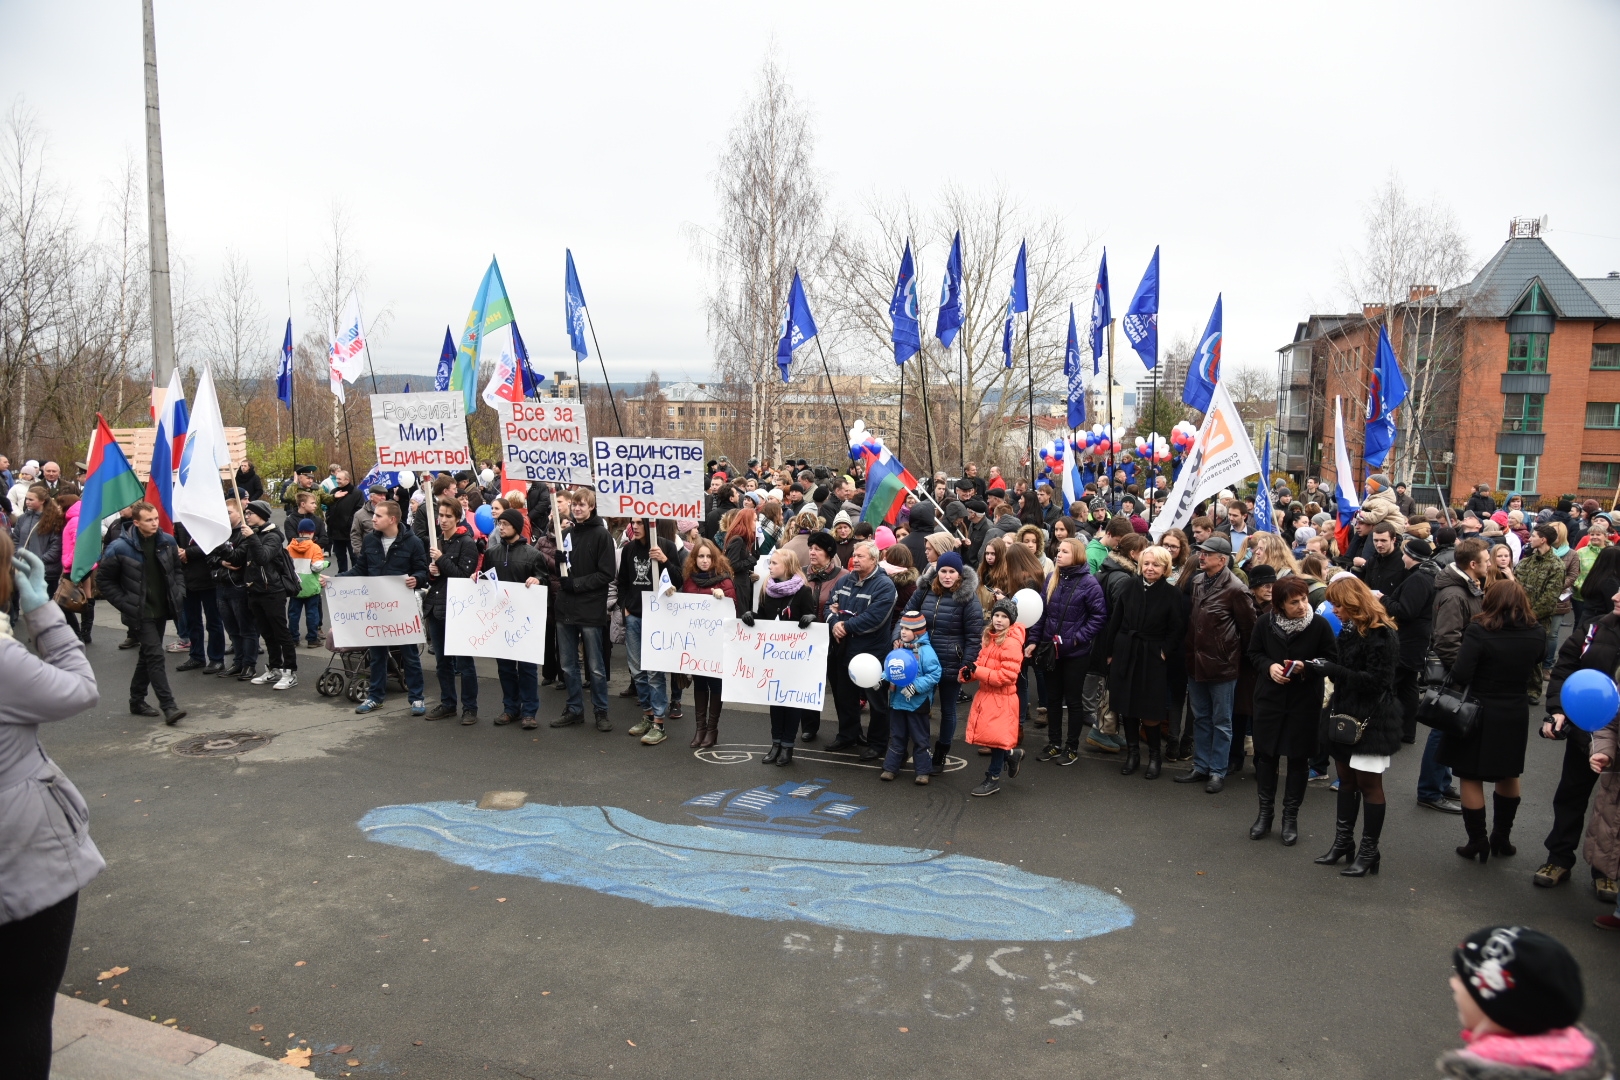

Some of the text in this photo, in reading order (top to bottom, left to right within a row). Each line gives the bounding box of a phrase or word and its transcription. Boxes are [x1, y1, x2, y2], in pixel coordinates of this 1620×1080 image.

[383, 399, 458, 421] Россия!
[512, 403, 573, 422] Все за
[399, 422, 445, 446] Мир!
[505, 422, 580, 445] Россию!
[378, 445, 470, 468] Единство!
[507, 444, 589, 469] Россия за
[595, 441, 703, 462] В единстве
[525, 465, 572, 483] всех!
[597, 479, 655, 495] сила
[619, 495, 701, 519] России!
[325, 580, 370, 599] В единстве
[365, 600, 399, 612] народа
[448, 584, 490, 620] Все за
[475, 588, 512, 626] Россию!
[649, 594, 711, 617] В единстве
[333, 609, 378, 624] единство
[365, 615, 421, 638] СТРАНЫ!
[468, 605, 516, 650] Россия за
[650, 630, 697, 651] СИЛА
[731, 622, 808, 651] Мы за сильную
[762, 642, 813, 661] Россию!
[732, 657, 774, 689] Мы за
[767, 679, 823, 705] Путина!
